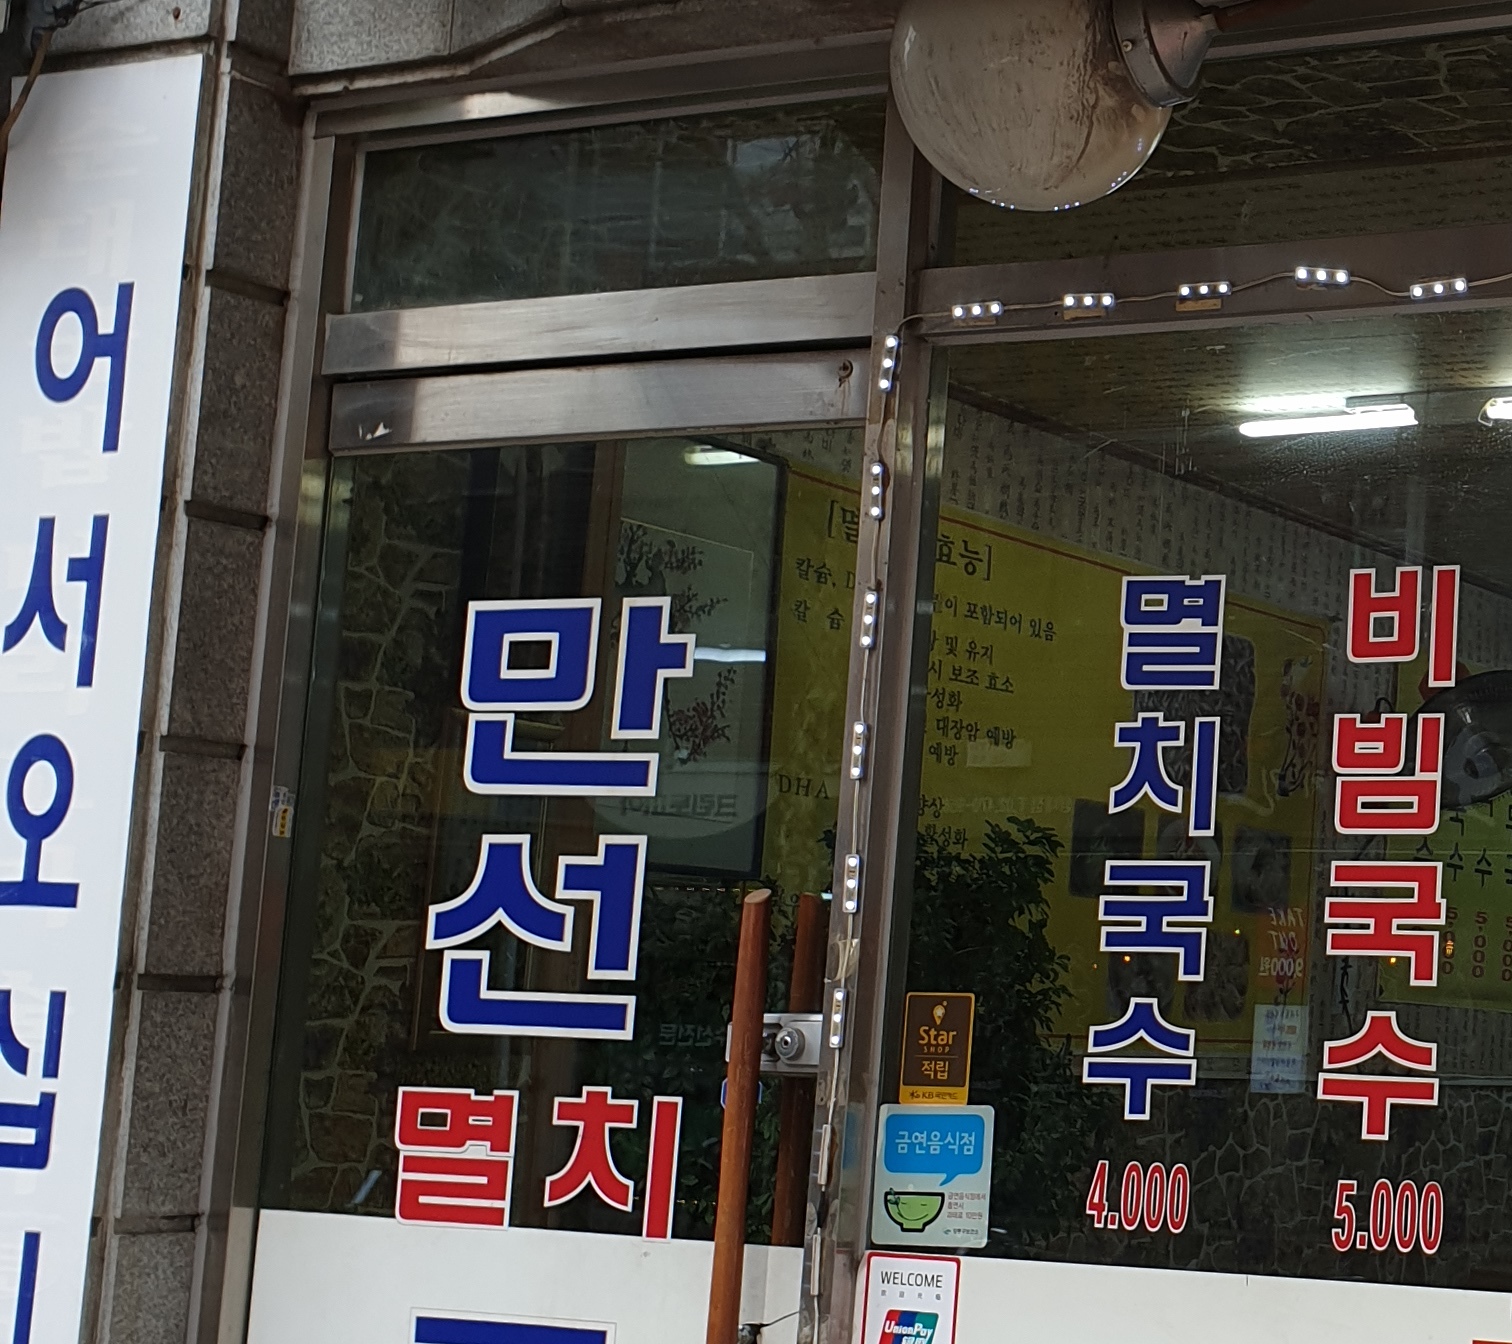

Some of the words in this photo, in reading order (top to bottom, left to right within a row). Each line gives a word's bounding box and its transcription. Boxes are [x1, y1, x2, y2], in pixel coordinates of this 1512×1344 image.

[964, 601, 1022, 635] 포함되어
[1029, 619, 1058, 642] 있음
[965, 641, 994, 665] 유지
[949, 663, 980, 686] 보조
[985, 670, 1015, 693] 효소
[935, 717, 980, 741] 대장암
[986, 726, 1018, 750] 예방
[928, 743, 960, 766] 예방
[427, 596, 697, 1041] 만선
[1082, 574, 1227, 1121] 멸치국수
[1316, 563, 1461, 1142] 비빔국수
[918, 1025, 957, 1045] Star
[921, 1060, 949, 1080] 적립
[895, 1130, 976, 1155] 금연음식점
[395, 1086, 684, 1243] 멸치
[1084, 1159, 1191, 1234] 4.000
[1331, 1178, 1444, 1255] 5.000
[880, 1270, 943, 1289] WELCOME
[884, 1320, 934, 1340] UnionPay
